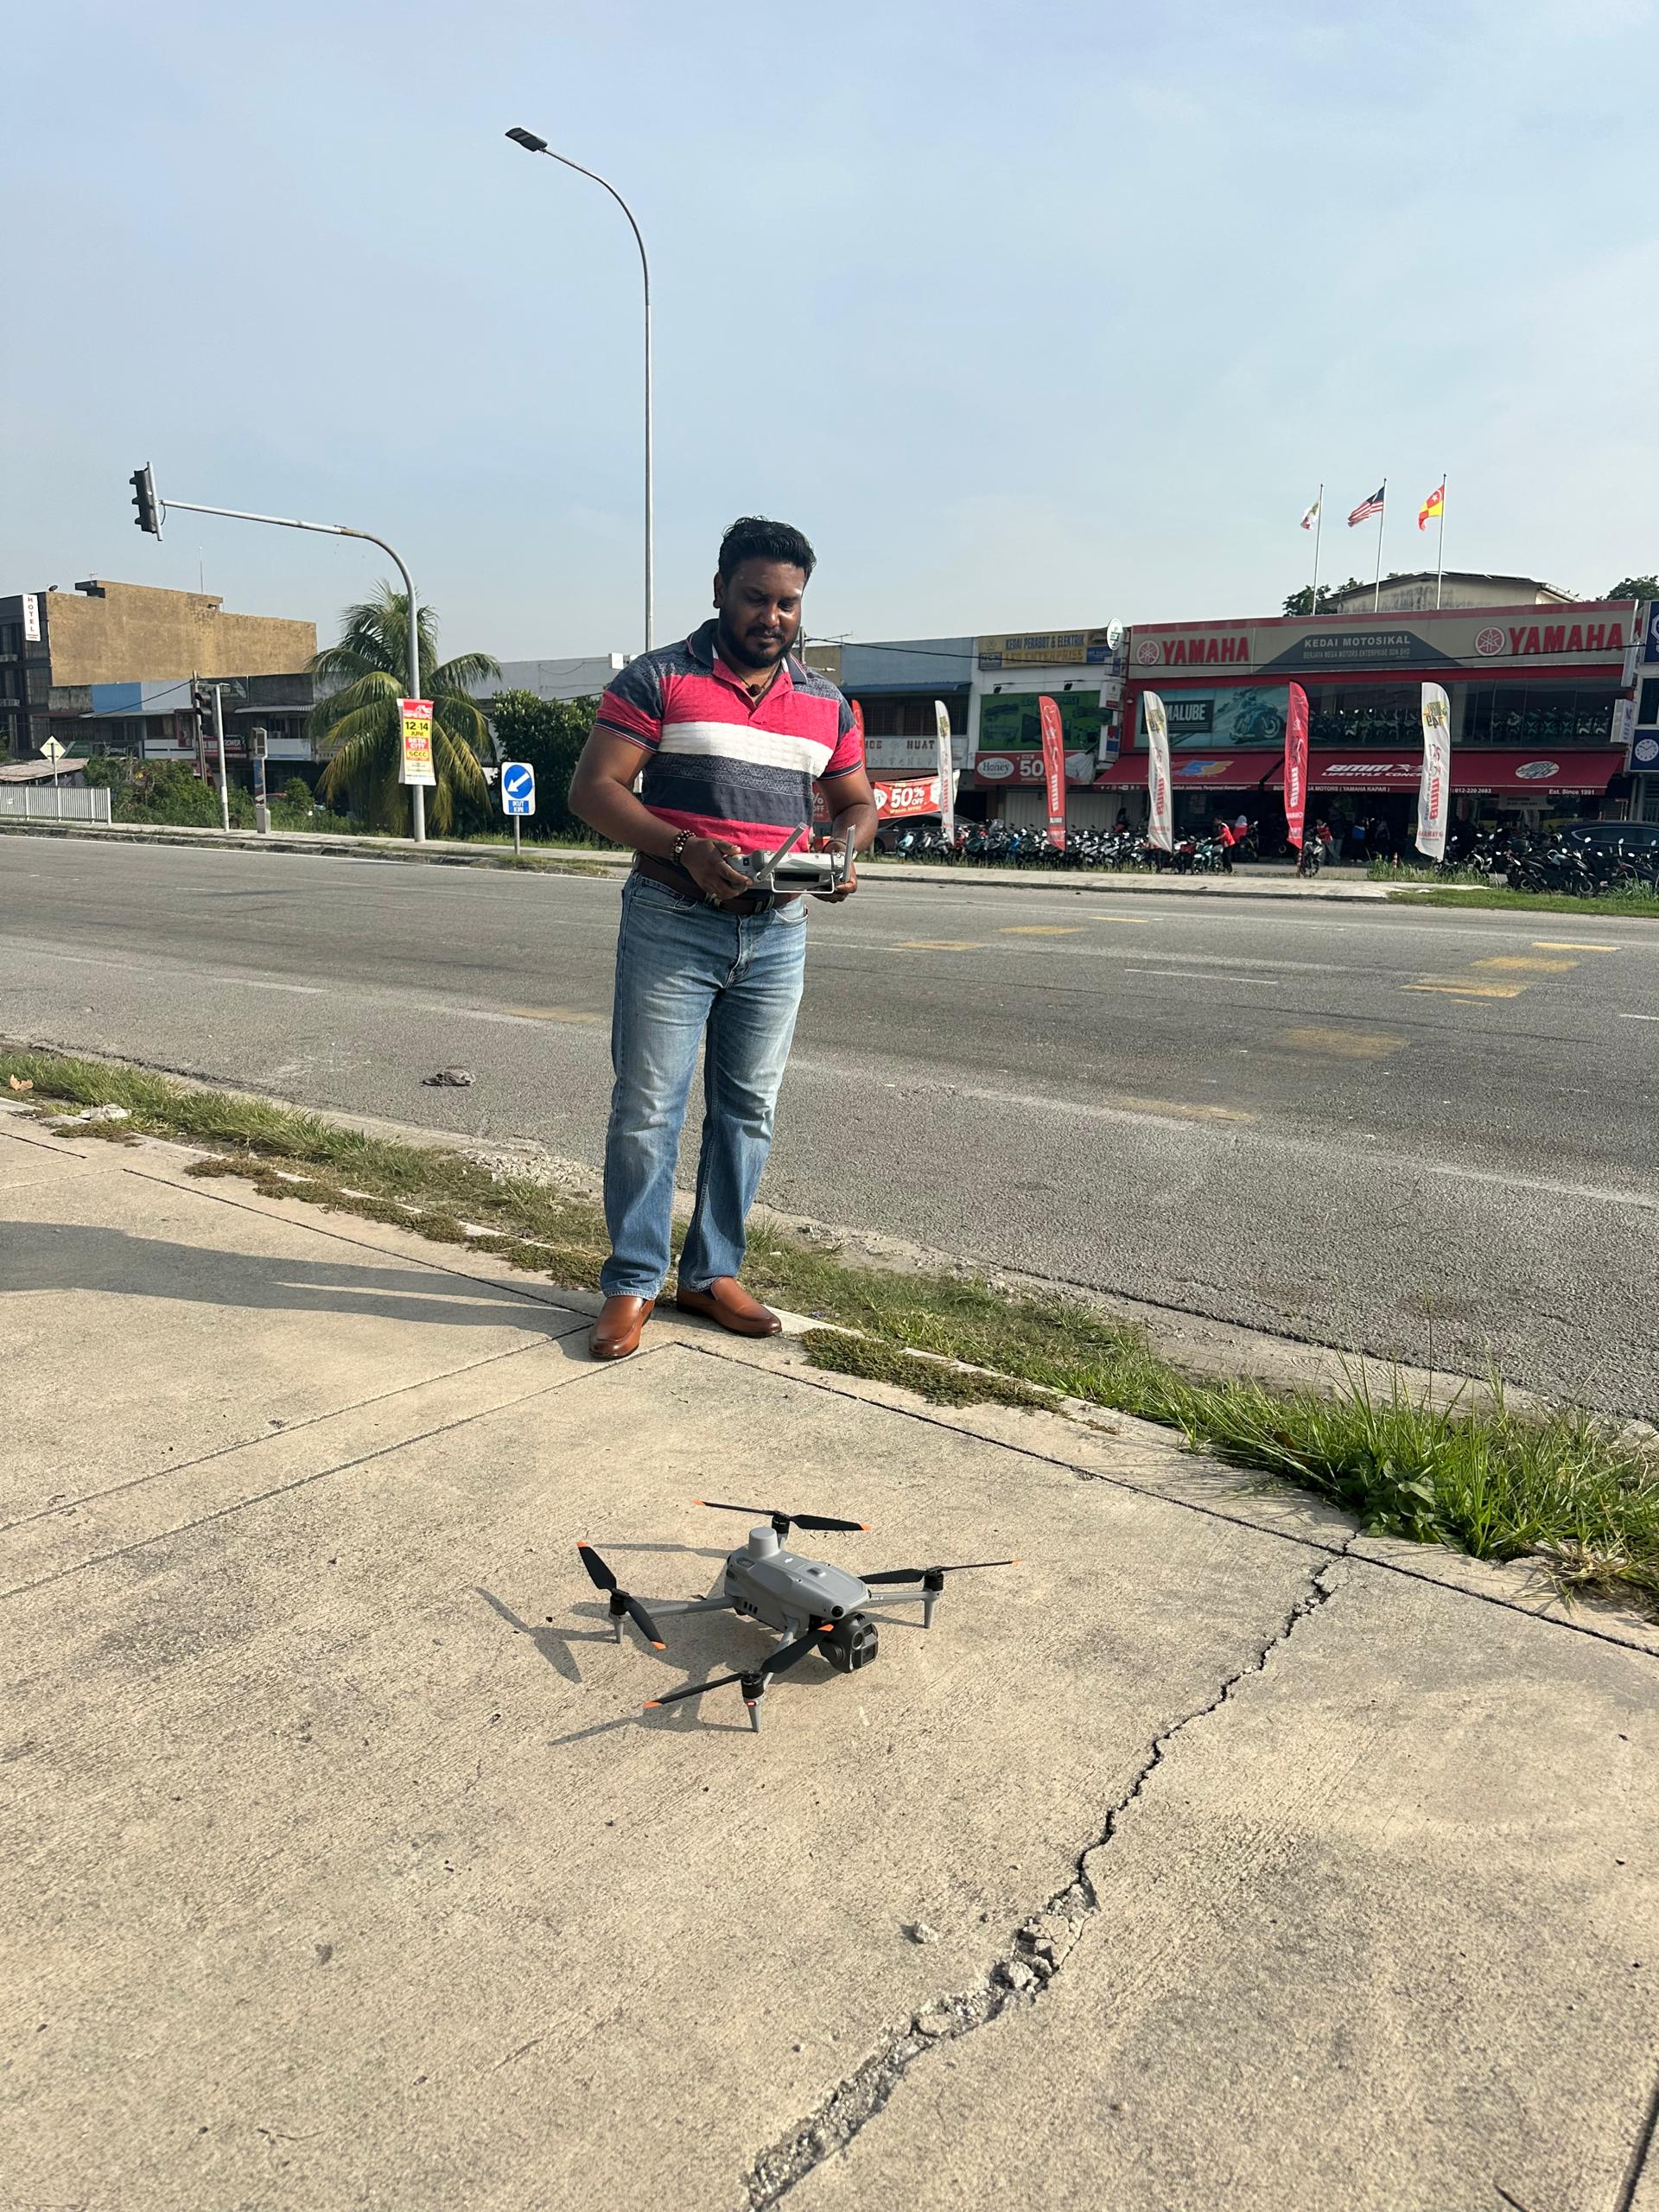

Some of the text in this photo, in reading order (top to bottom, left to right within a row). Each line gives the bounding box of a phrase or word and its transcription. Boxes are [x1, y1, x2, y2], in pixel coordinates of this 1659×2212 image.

[1304, 635, 1411, 648] KEDAI MOTOSIKAL
[1509, 623, 1623, 655] YAMAHA
[1161, 637, 1249, 664] YAMAHA
[1166, 703, 1206, 721] MALUBE
[906, 740, 935, 749] HUAT
[982, 760, 1011, 775] Honey
